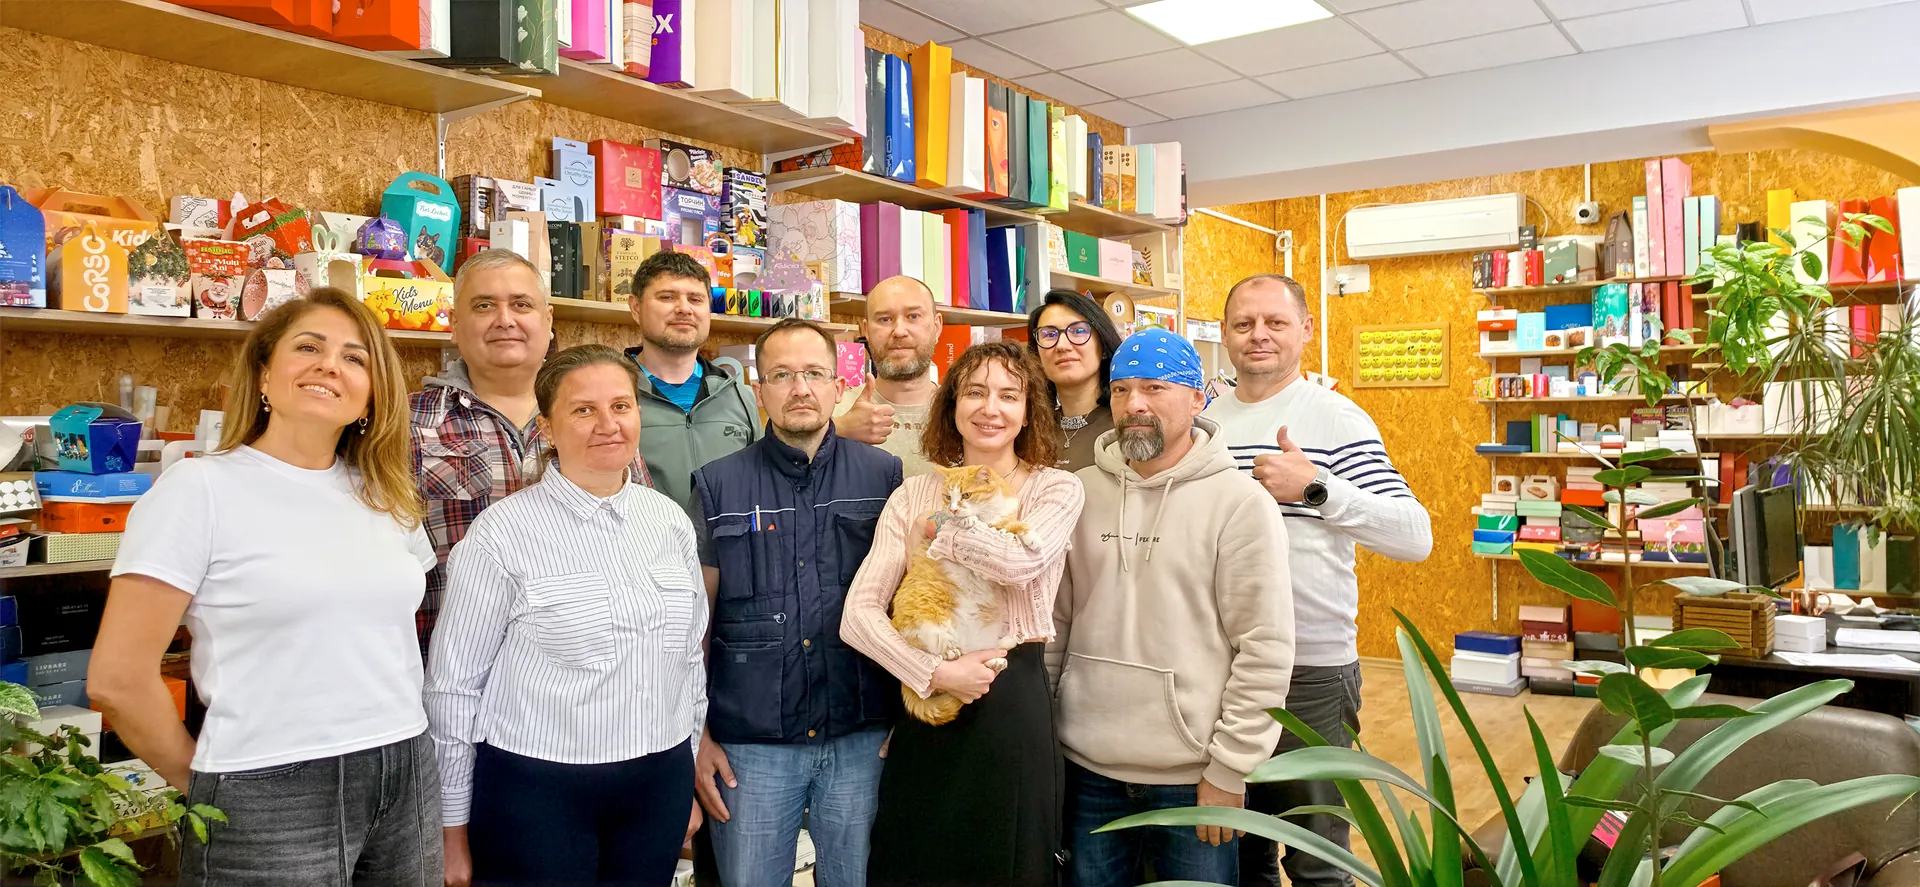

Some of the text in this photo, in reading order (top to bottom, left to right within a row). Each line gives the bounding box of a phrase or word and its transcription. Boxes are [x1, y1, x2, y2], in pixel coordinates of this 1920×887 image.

[680, 196, 704, 207] ТОРЧИН
[208, 263, 228, 271] Ani
[392, 286, 419, 304] Kids
[401, 299, 434, 316] Menu
